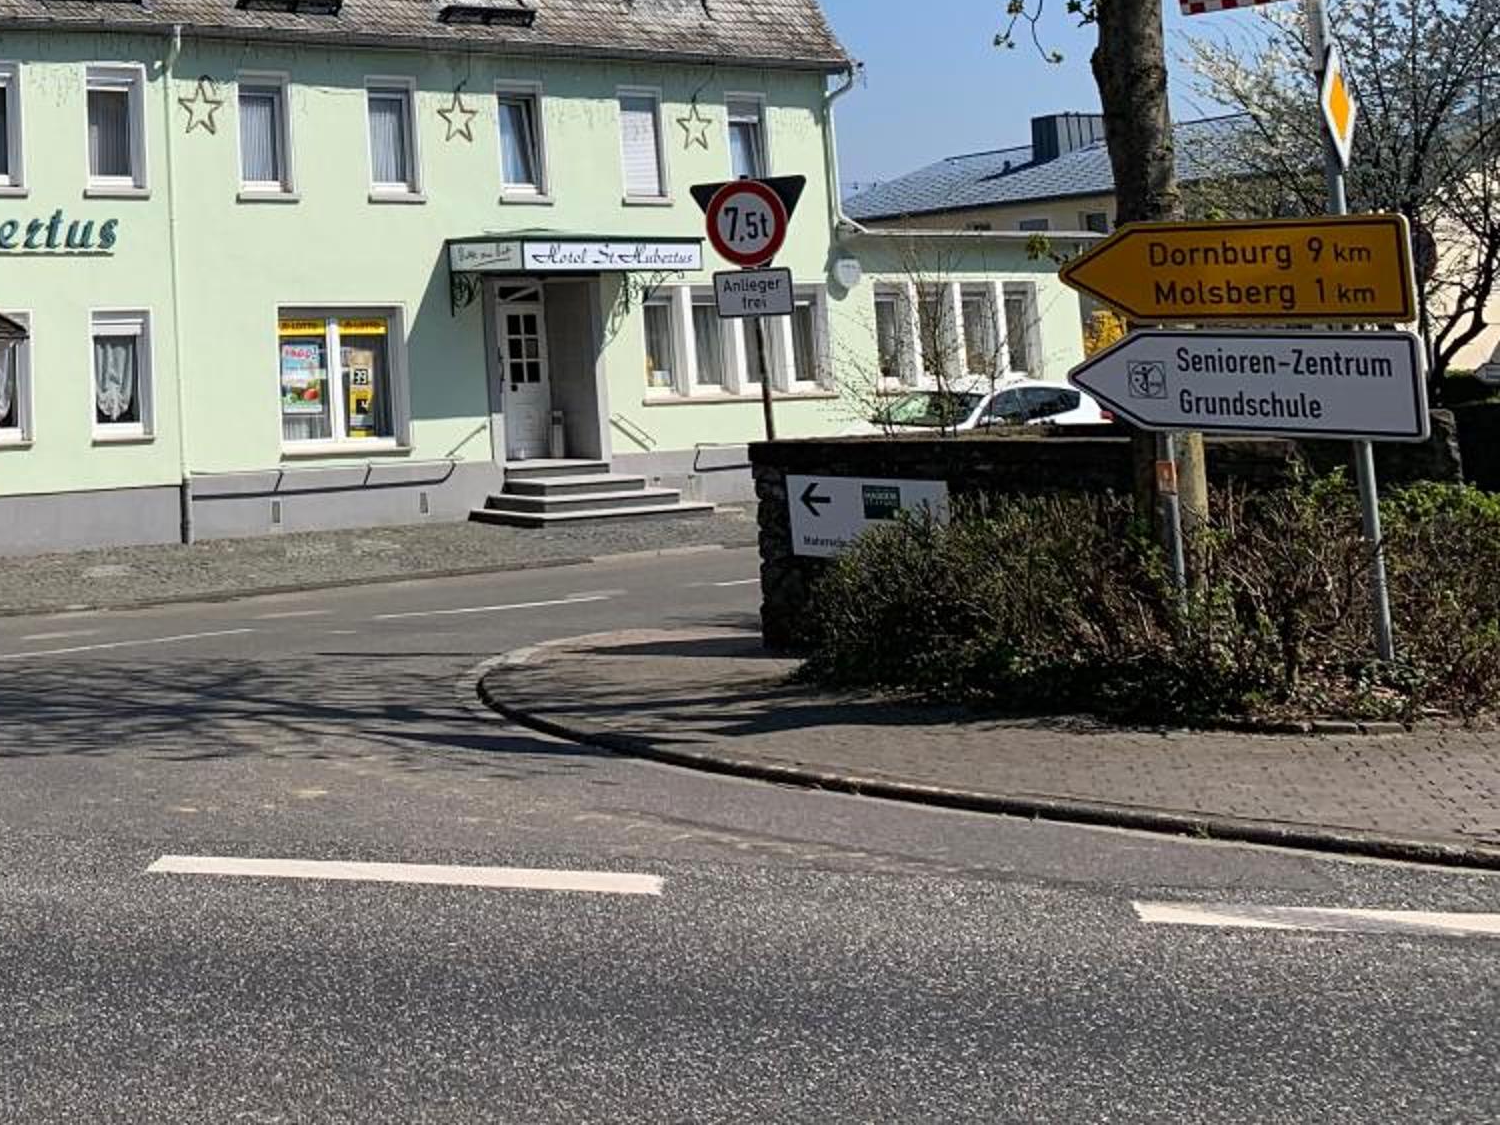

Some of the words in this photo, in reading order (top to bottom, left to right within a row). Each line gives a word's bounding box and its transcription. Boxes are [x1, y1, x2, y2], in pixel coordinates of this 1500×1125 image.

[532, 242, 587, 264] Hotel
[618, 241, 693, 264] Hubertus
[1149, 240, 1293, 271] Dornburg
[1306, 236, 1324, 263] 9
[1333, 242, 1372, 263] km
[723, 278, 781, 293] Anlieger
[1154, 280, 1297, 310] Molsberg
[1314, 278, 1326, 304] 1
[1336, 284, 1376, 304] km
[742, 296, 767, 309] frei
[1176, 347, 1393, 377] Senioren-Zentrum
[1179, 389, 1323, 419] Grundschule
